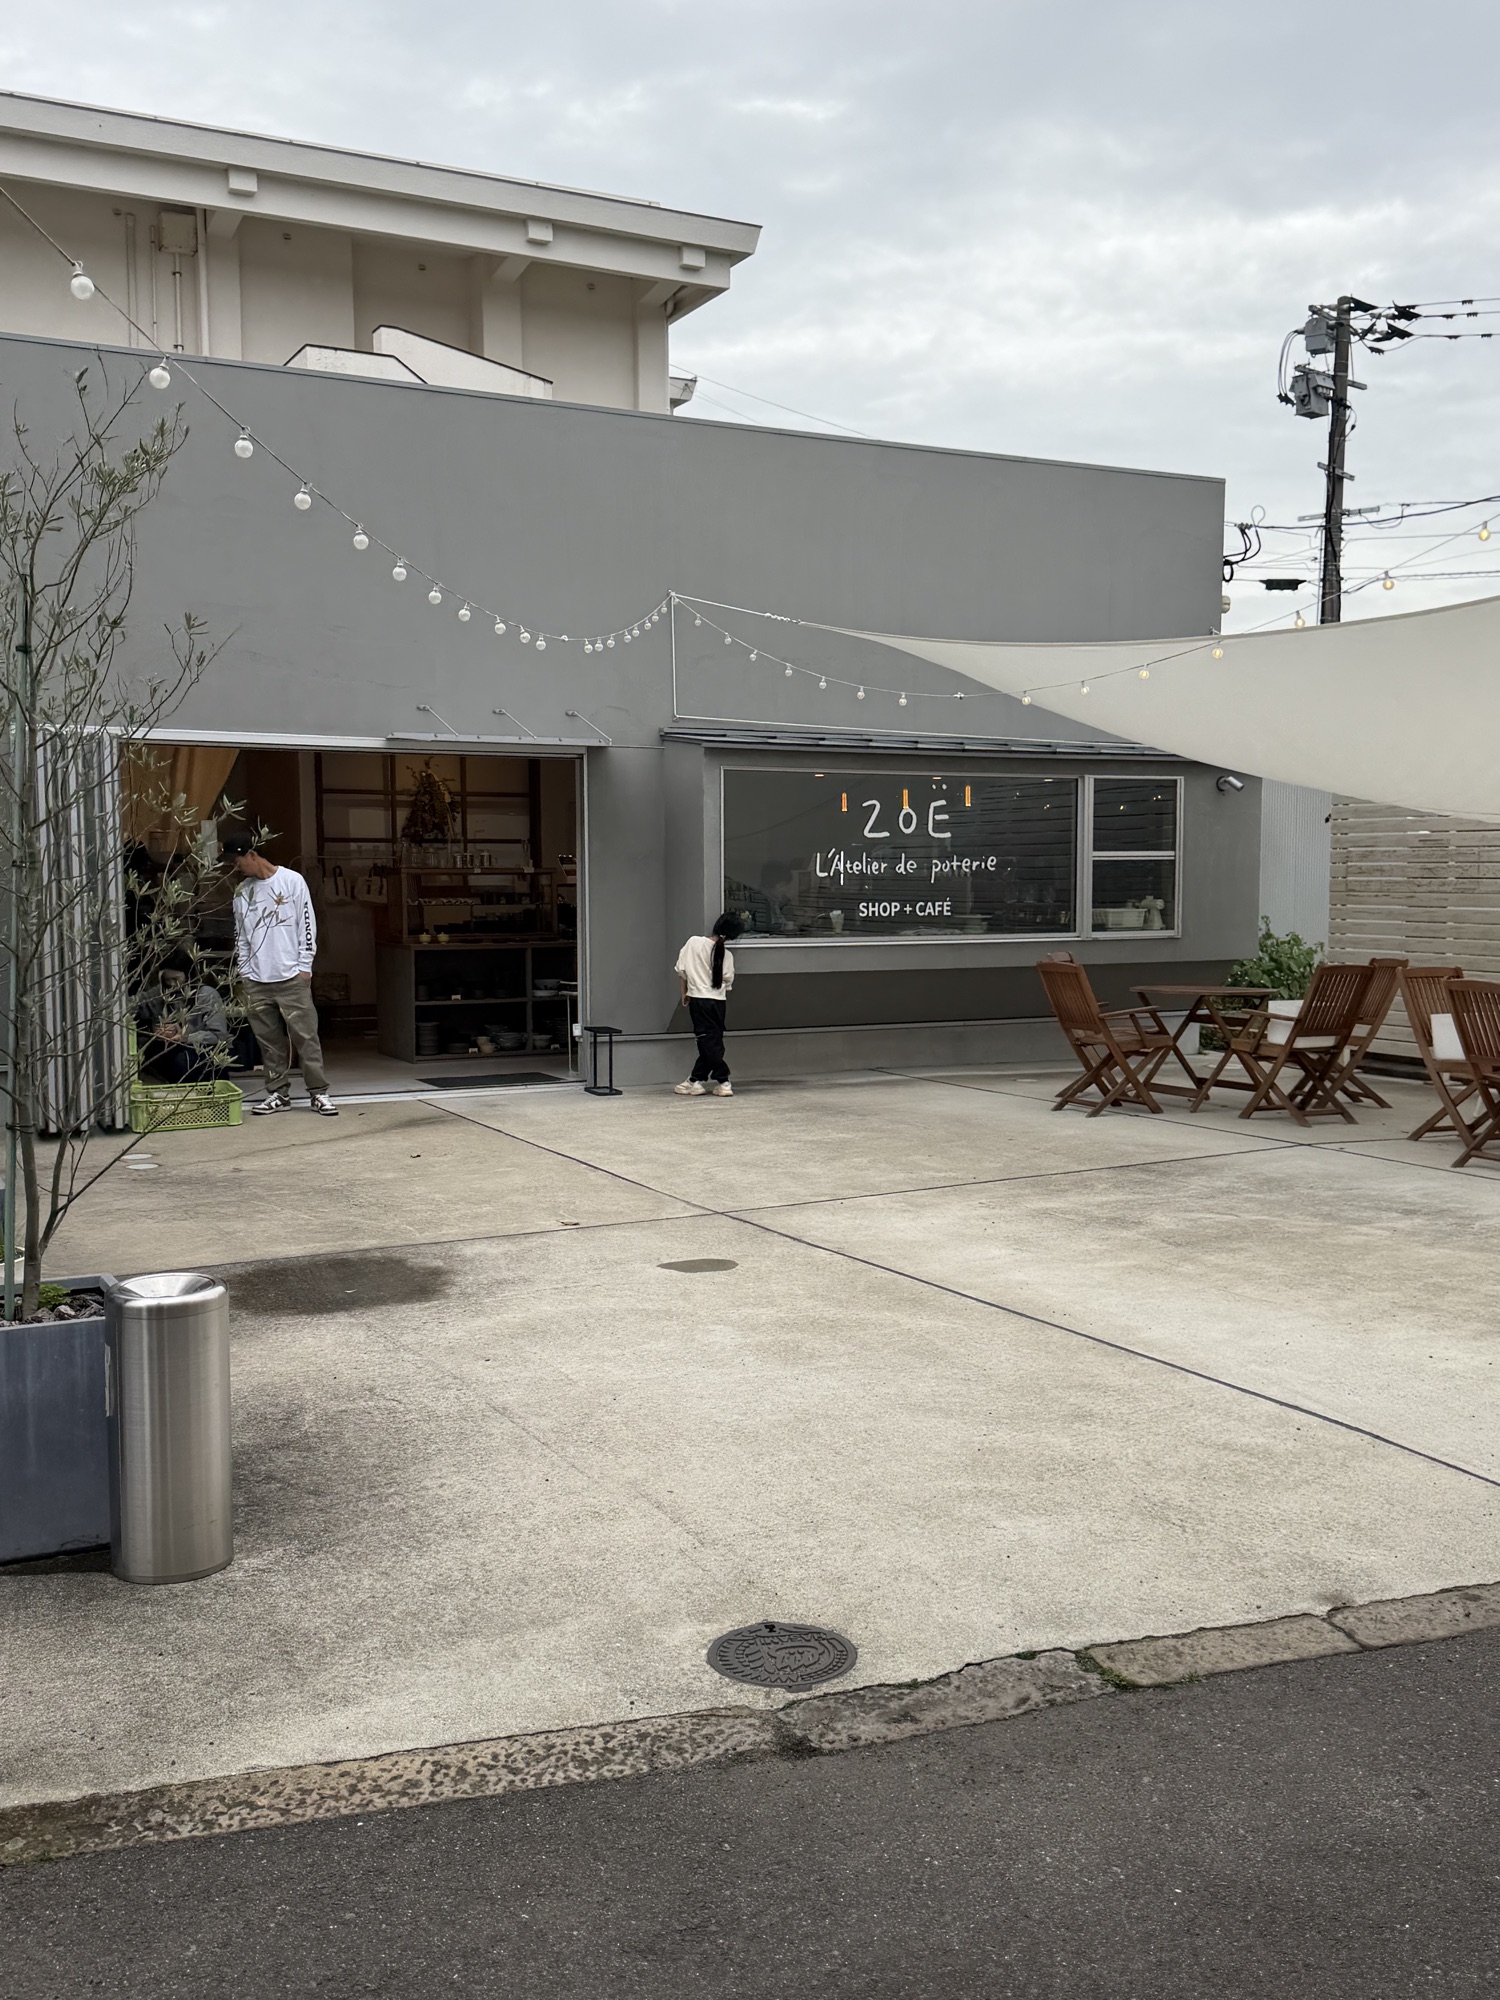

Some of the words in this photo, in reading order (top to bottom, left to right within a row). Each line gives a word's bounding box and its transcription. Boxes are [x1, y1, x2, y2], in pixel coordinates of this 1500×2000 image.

[896, 853, 917, 875] de
[931, 854, 997, 883] poterie
[859, 902, 900, 917] SHOP
[916, 898, 951, 916] CAFÉ
[304, 901, 313, 951] HONDA
